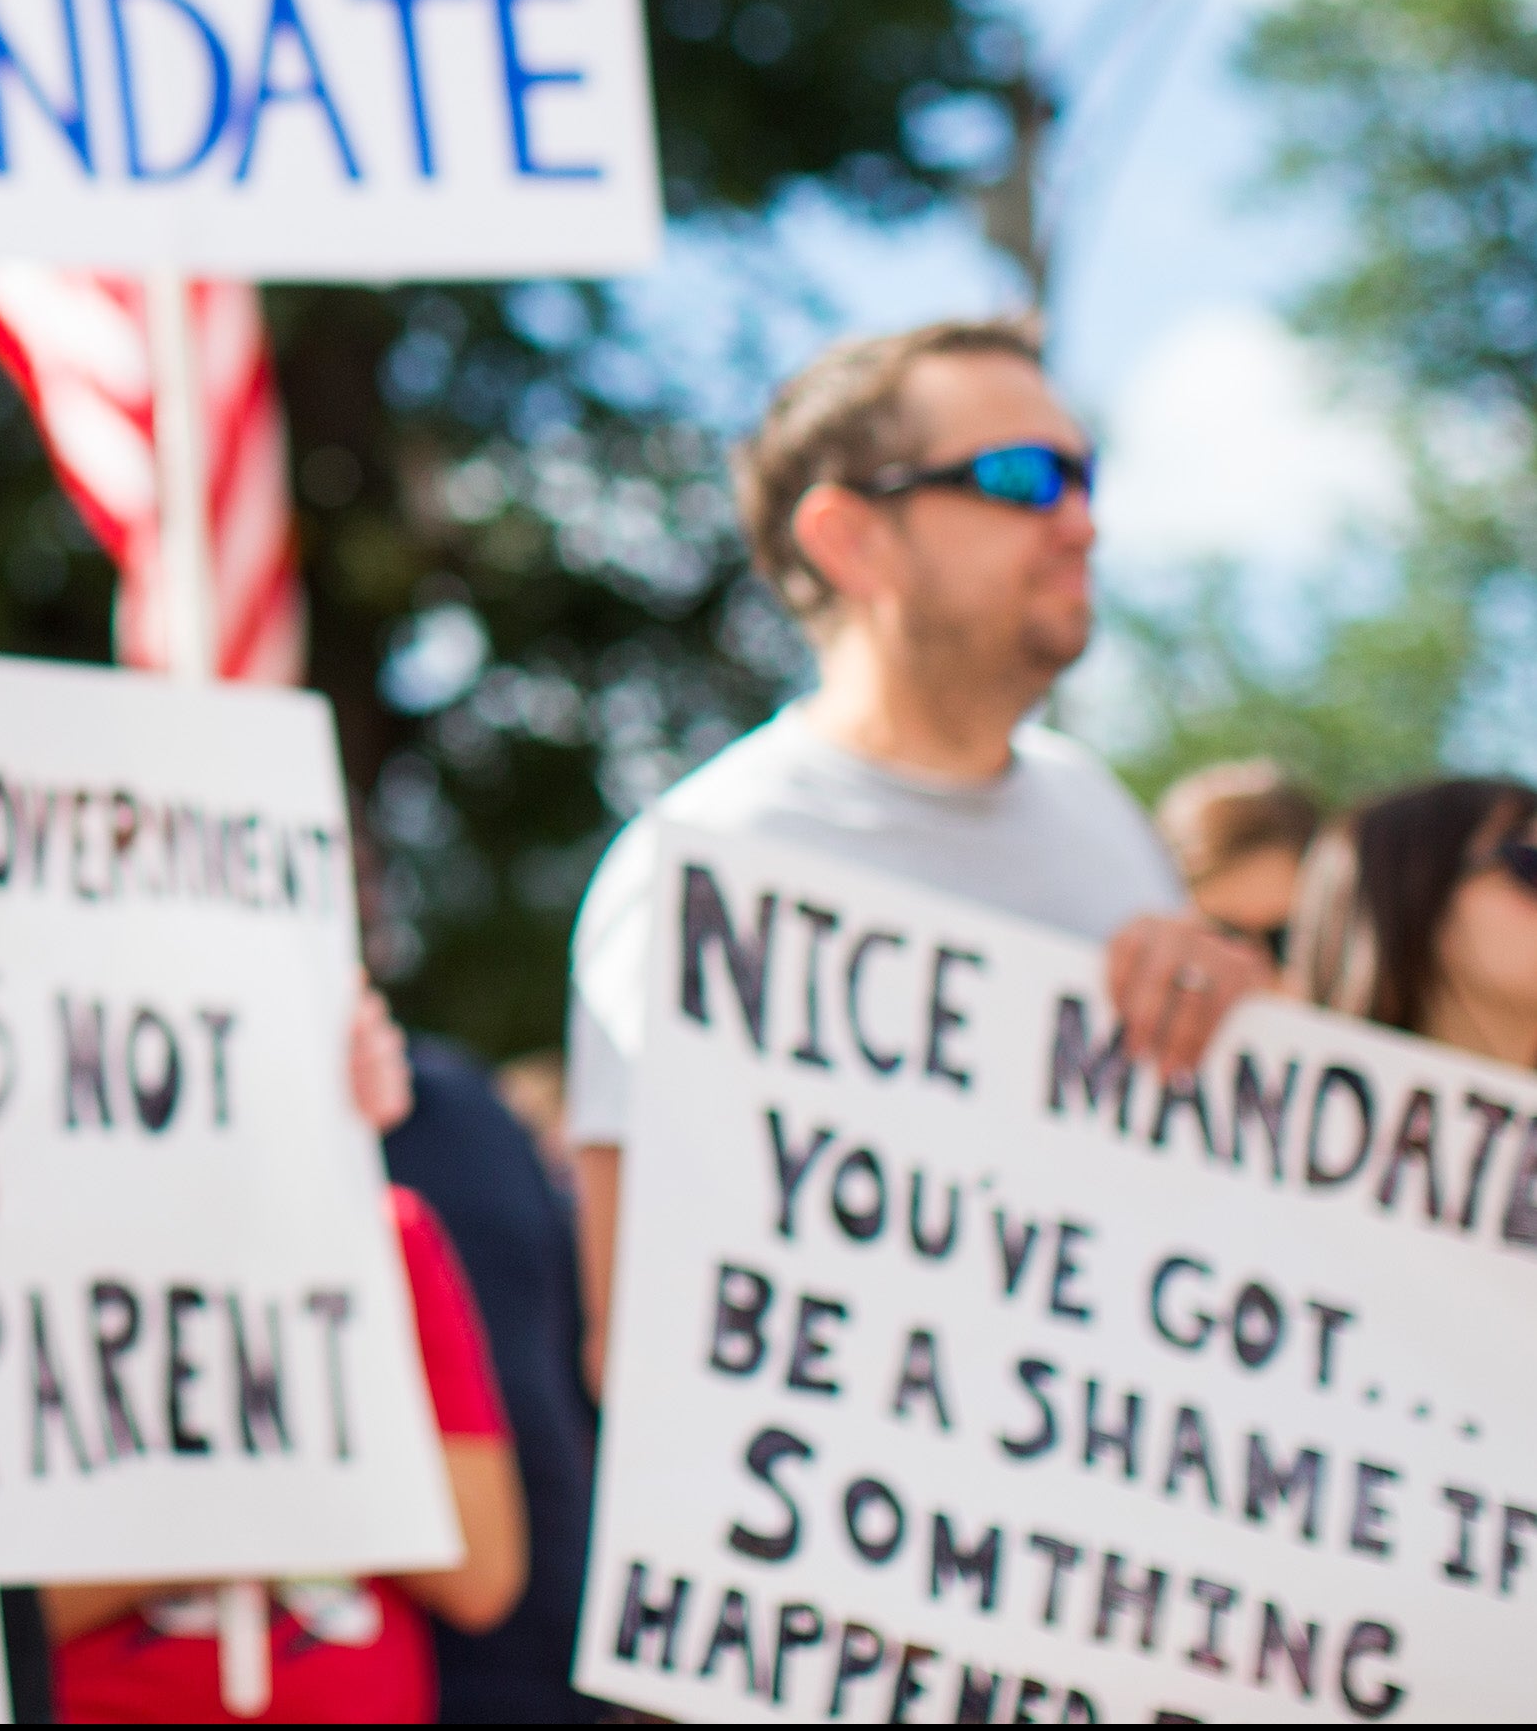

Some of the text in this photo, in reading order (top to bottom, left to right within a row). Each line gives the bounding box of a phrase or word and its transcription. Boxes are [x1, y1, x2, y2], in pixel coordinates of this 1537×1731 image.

[54, 990, 238, 1144] NOT
[676, 862, 986, 1093] NICE
[761, 1104, 1096, 1324] YOU'VE
[708, 1262, 1537, 1598] BE A SHAME IF
[726, 1424, 1408, 1720] SOMTHING
